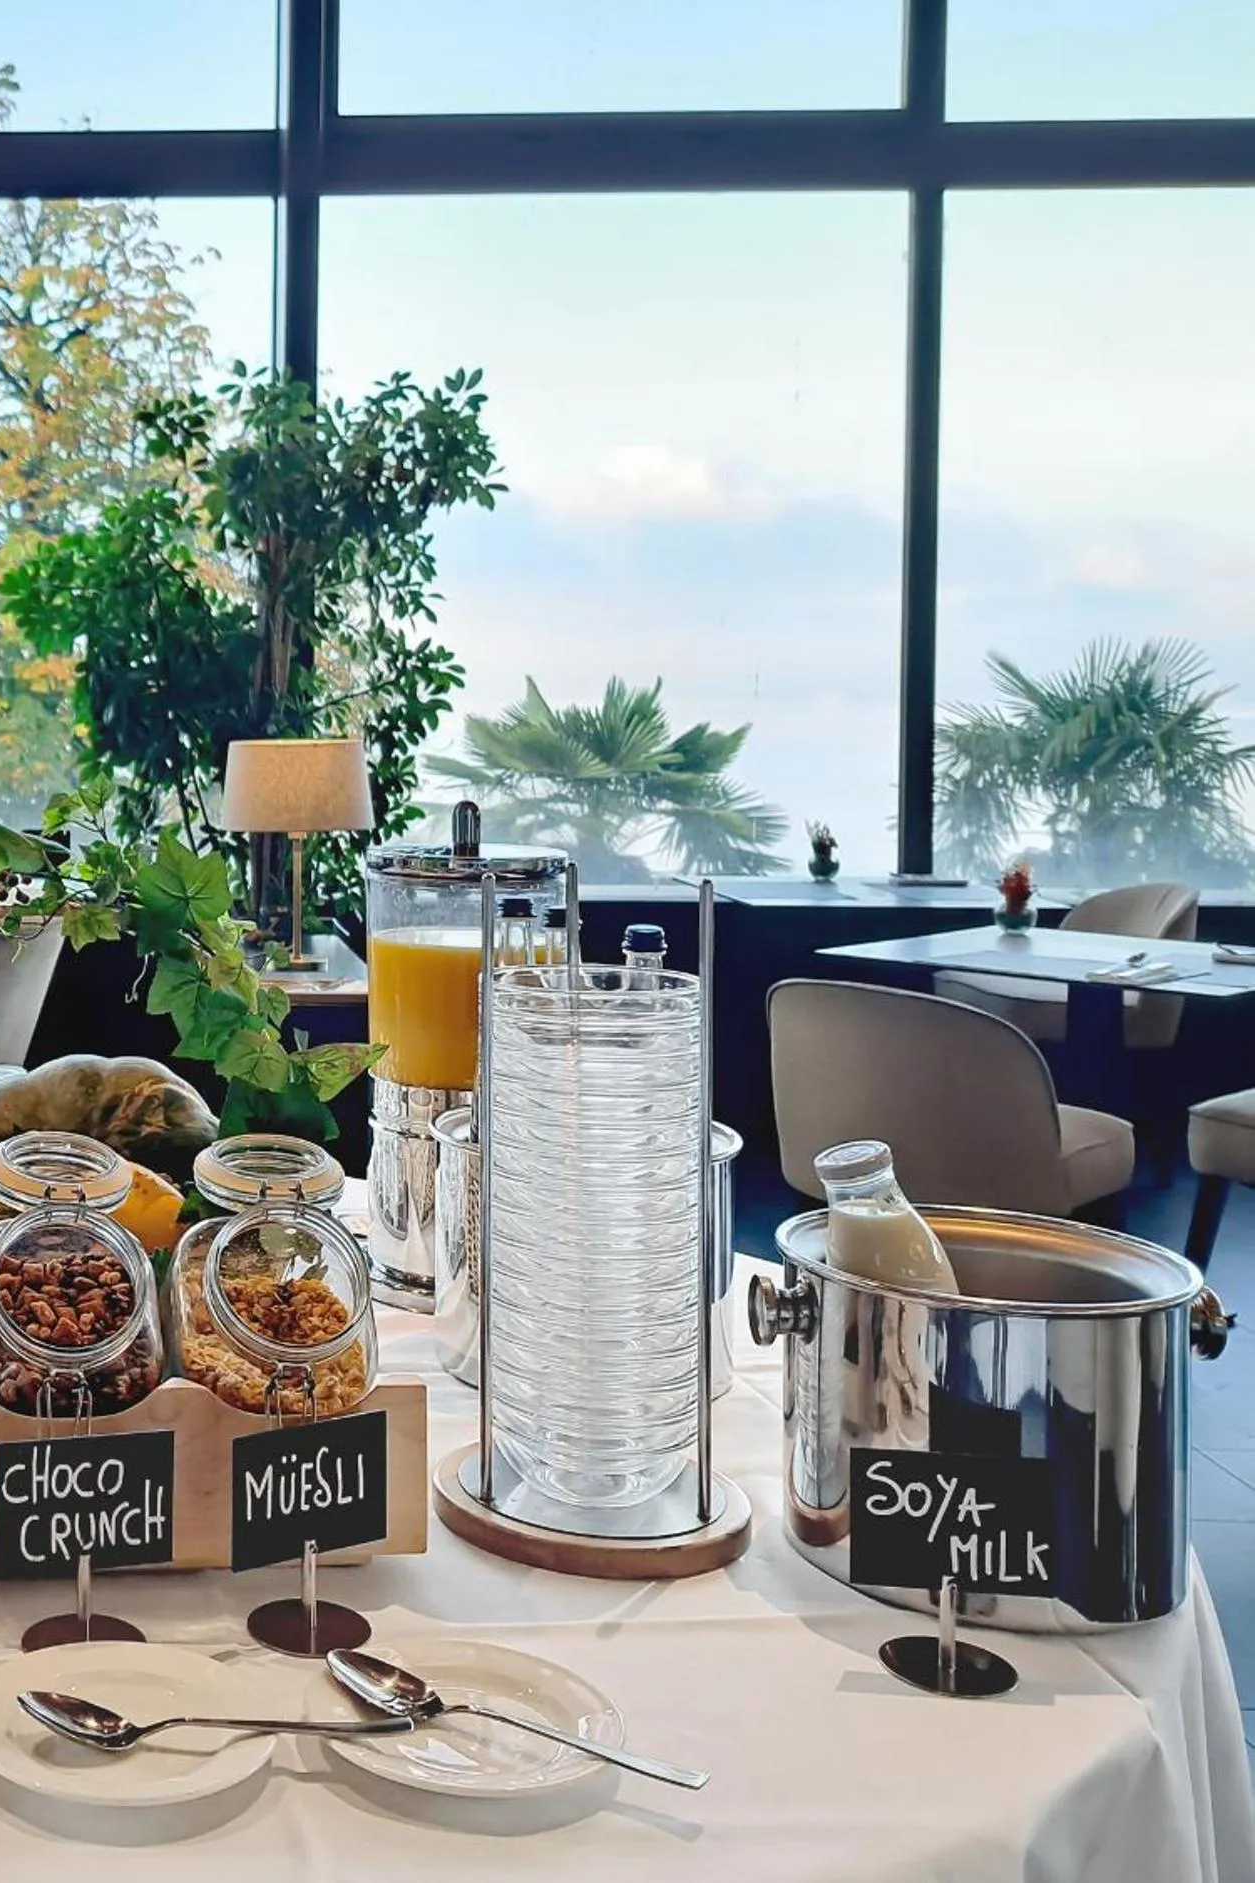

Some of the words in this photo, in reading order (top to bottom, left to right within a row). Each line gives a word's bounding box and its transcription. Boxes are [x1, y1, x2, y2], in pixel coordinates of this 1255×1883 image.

[1, 1444, 125, 1504] CHOCO
[245, 1446, 364, 1522] MÜESLI
[865, 1460, 995, 1543] SOYA
[20, 1479, 165, 1562] CRUNCH
[949, 1530, 1049, 1581] MILK
